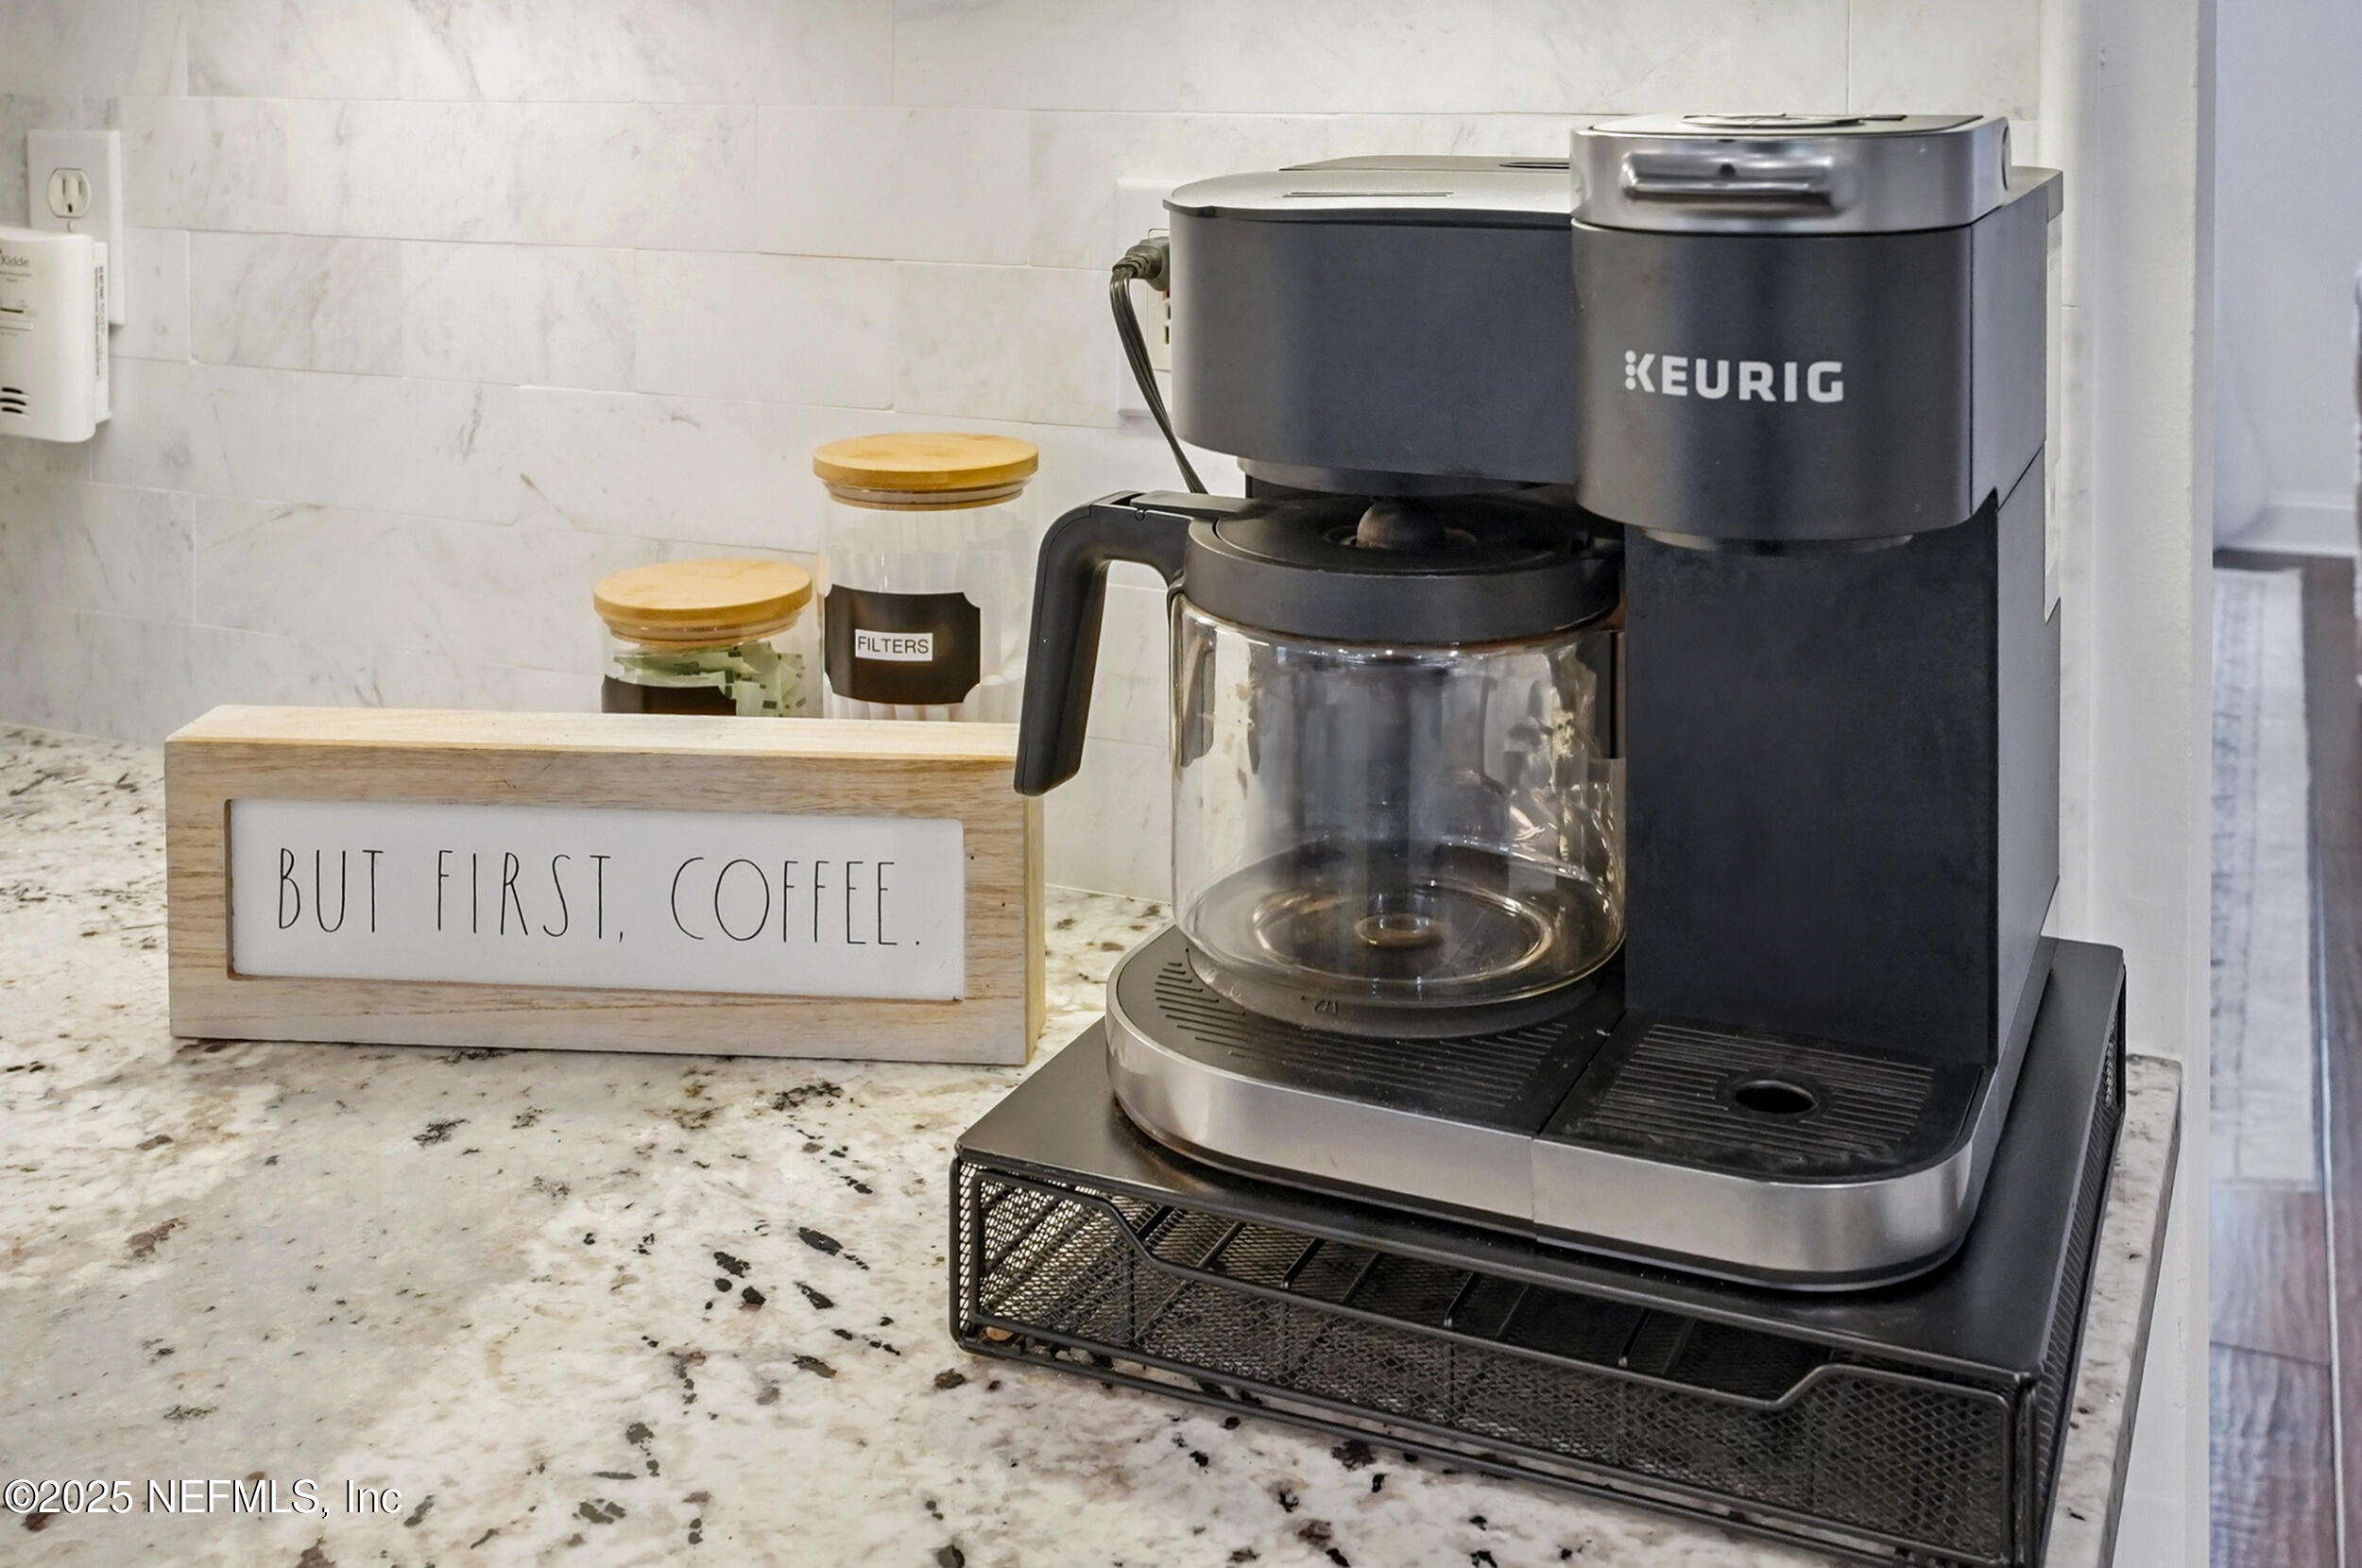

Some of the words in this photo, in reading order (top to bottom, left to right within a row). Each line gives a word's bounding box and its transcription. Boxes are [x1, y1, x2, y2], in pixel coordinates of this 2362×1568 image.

[1625, 349, 1843, 403] KEURIG
[858, 636, 929, 655] FILTERS
[279, 847, 384, 934] BUT
[437, 849, 625, 943] FIRST,
[671, 857, 921, 946] COFFEE.
